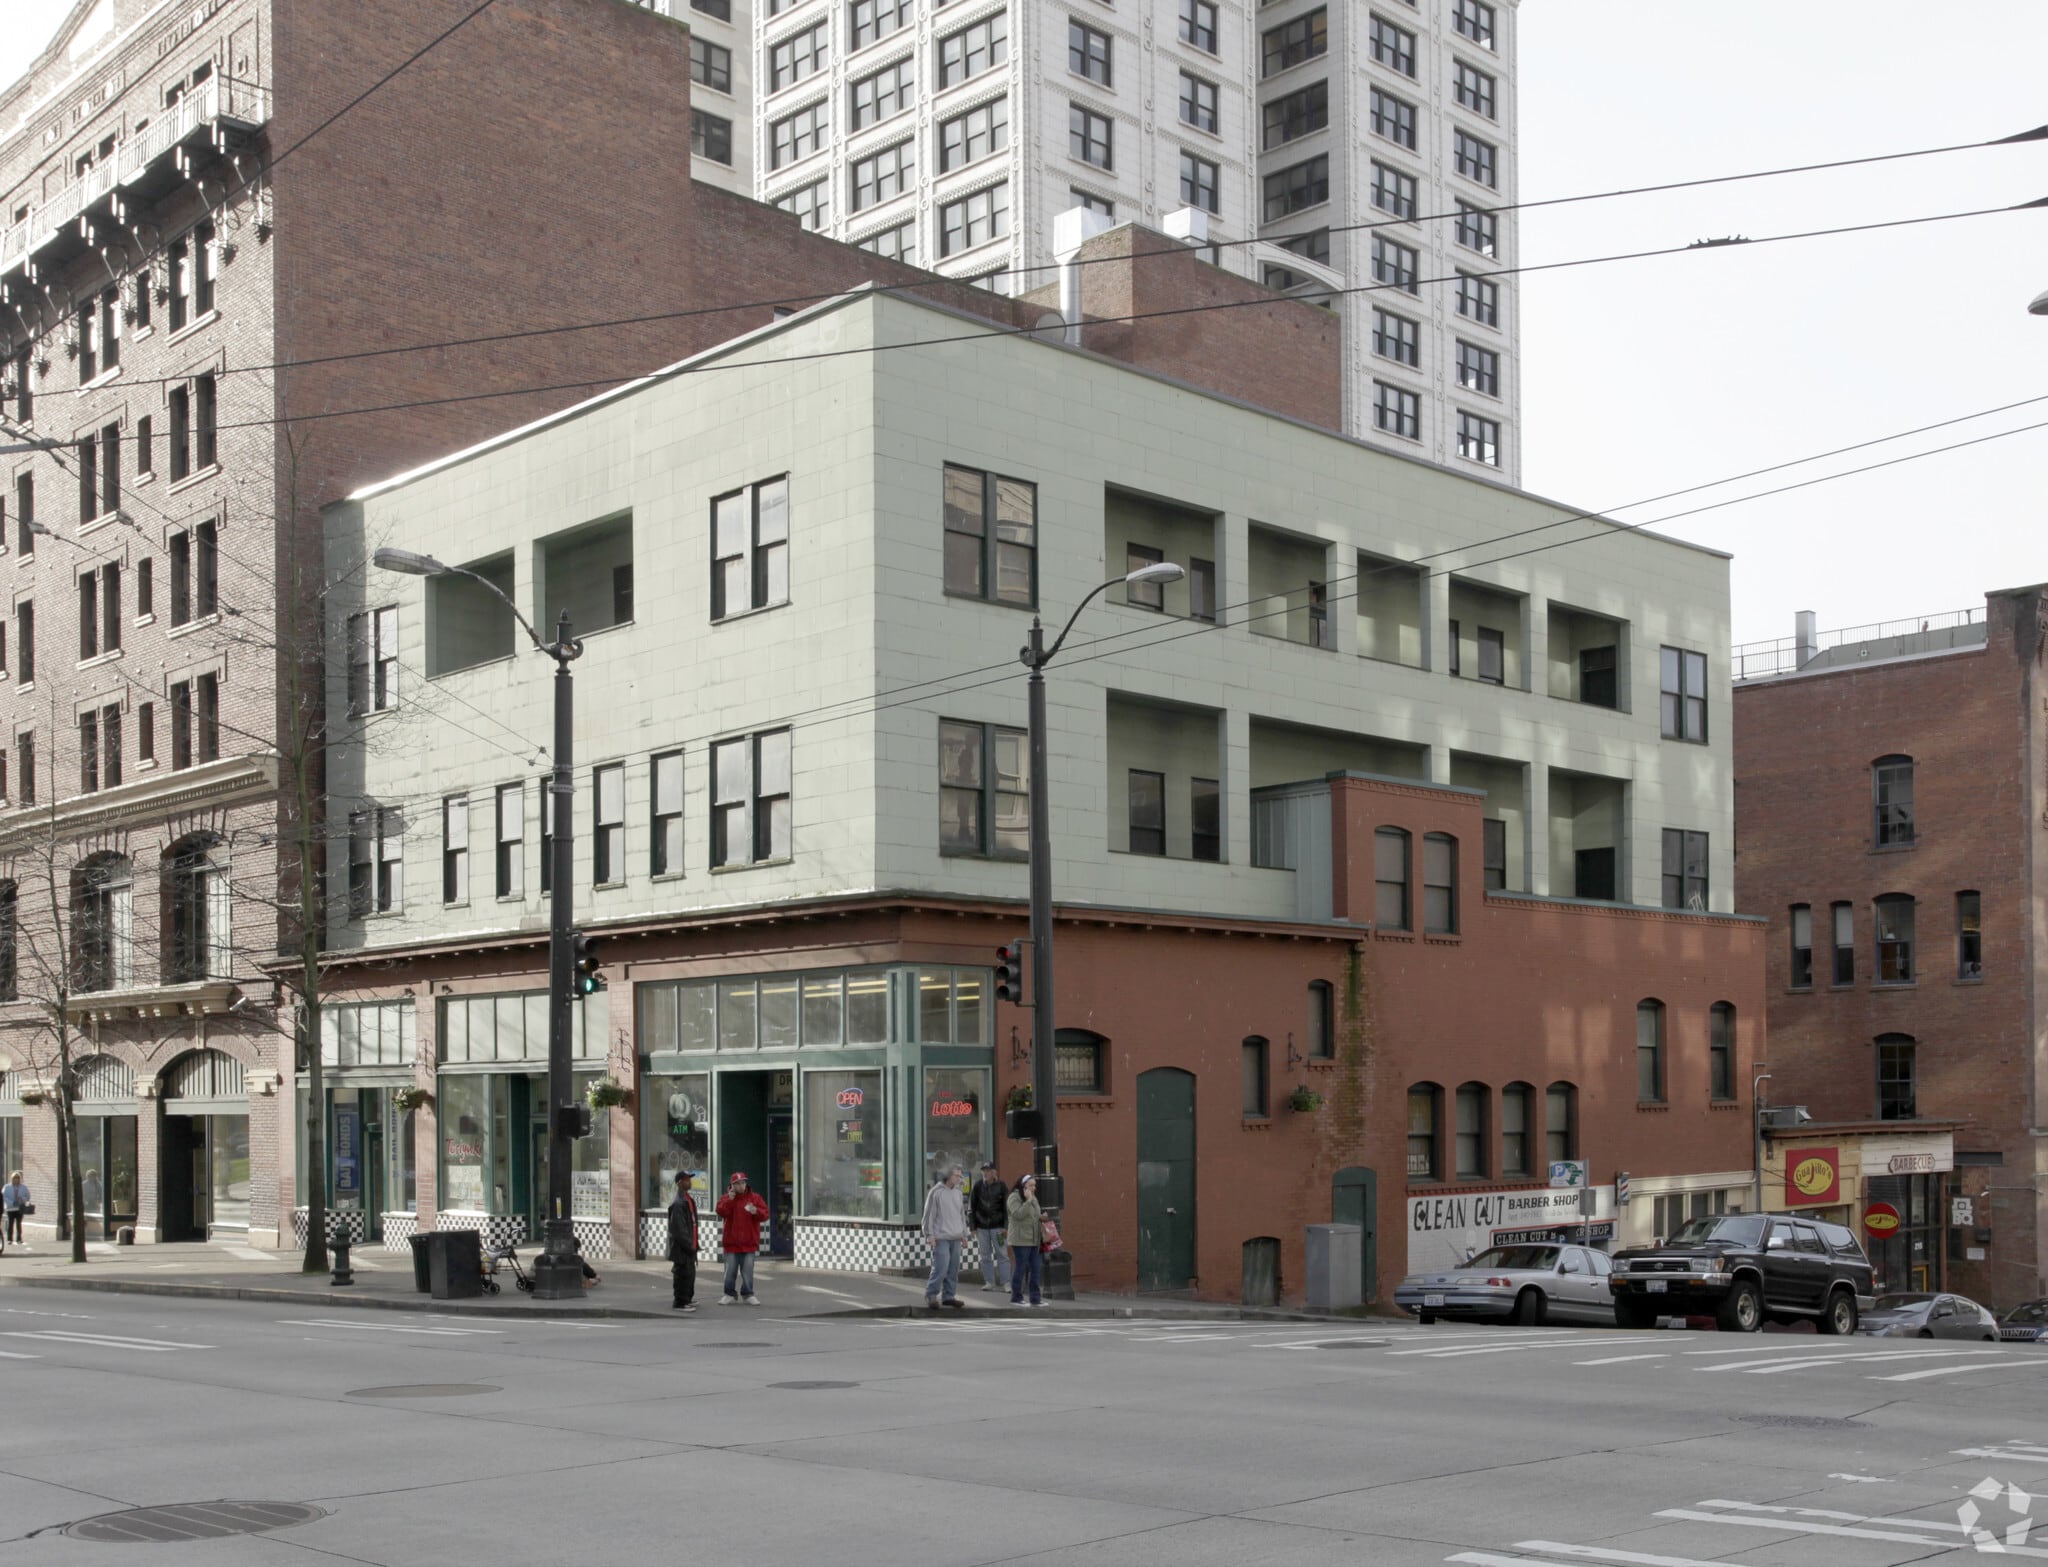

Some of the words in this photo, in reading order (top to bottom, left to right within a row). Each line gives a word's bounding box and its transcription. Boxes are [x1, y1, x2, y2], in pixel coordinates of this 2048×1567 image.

[836, 1091, 863, 1105] OPEN
[932, 1100, 973, 1117] Lotto
[340, 1115, 352, 1158] BONDS
[673, 1124, 689, 1135] ATM
[391, 1139, 399, 1161] BAIL
[1555, 1165, 1563, 1176] P
[1894, 1156, 1932, 1171] BARBECUE
[340, 1160, 352, 1188] BAIL
[1508, 1196, 1550, 1210] BARBER
[1553, 1194, 1578, 1207] SHOP
[1414, 1197, 1467, 1231] CLEAN
[1474, 1196, 1505, 1226] CUT
[1496, 1232, 1527, 1245] CLEAN
[1530, 1231, 1548, 1242] CUT
